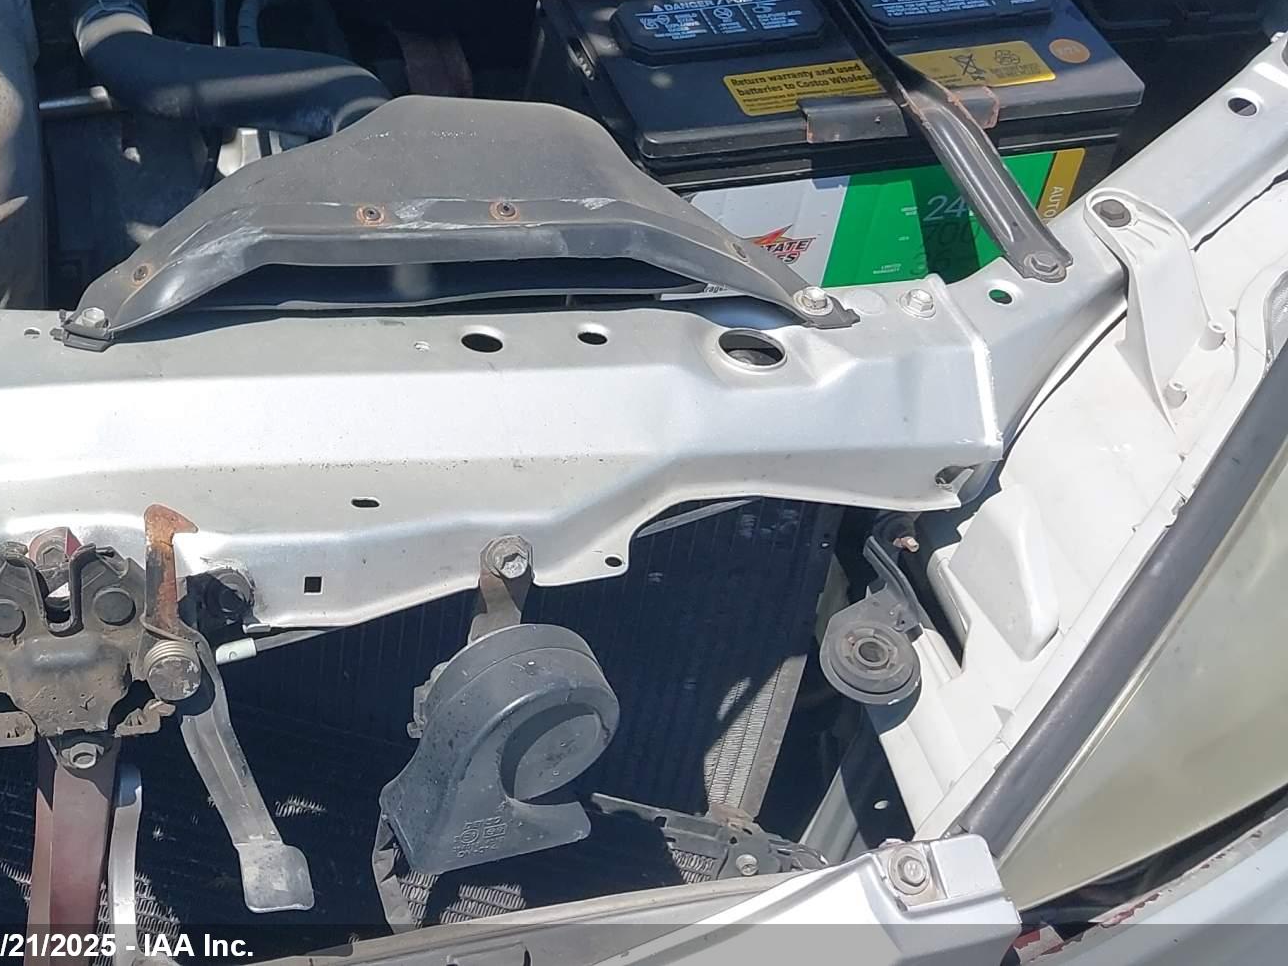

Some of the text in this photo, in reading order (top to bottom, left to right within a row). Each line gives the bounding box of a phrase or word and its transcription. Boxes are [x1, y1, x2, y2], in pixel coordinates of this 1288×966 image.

[730, 63, 861, 86] Return warranty and used
[736, 84, 783, 96] batteries
[783, 83, 795, 91] to
[796, 78, 830, 88] Costco
[922, 194, 974, 222] 24
[1043, 186, 1065, 218] AUTO
